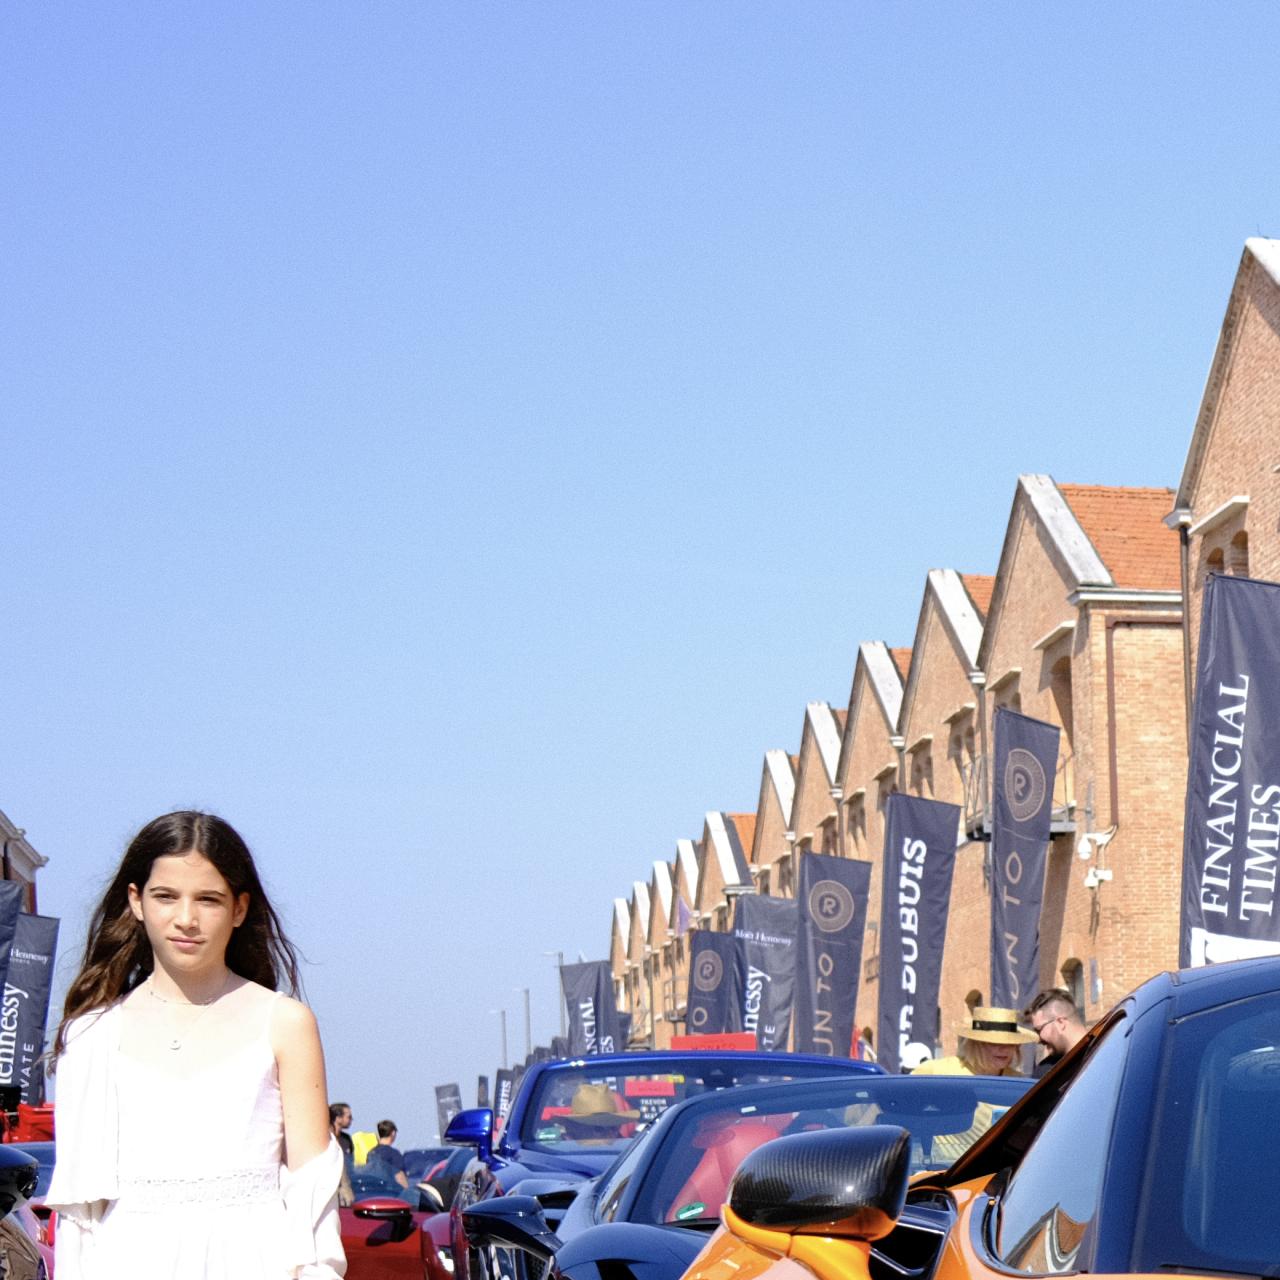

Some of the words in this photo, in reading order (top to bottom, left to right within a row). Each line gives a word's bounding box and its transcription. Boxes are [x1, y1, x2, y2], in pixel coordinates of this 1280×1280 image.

[1201, 674, 1250, 917] FINANCIAL
[1003, 851, 1023, 908] TO
[899, 837, 928, 994] DUBUIS
[744, 966, 771, 1035] nessy
[816, 952, 833, 994] TO
[20, 1041, 34, 1104] IVATE
